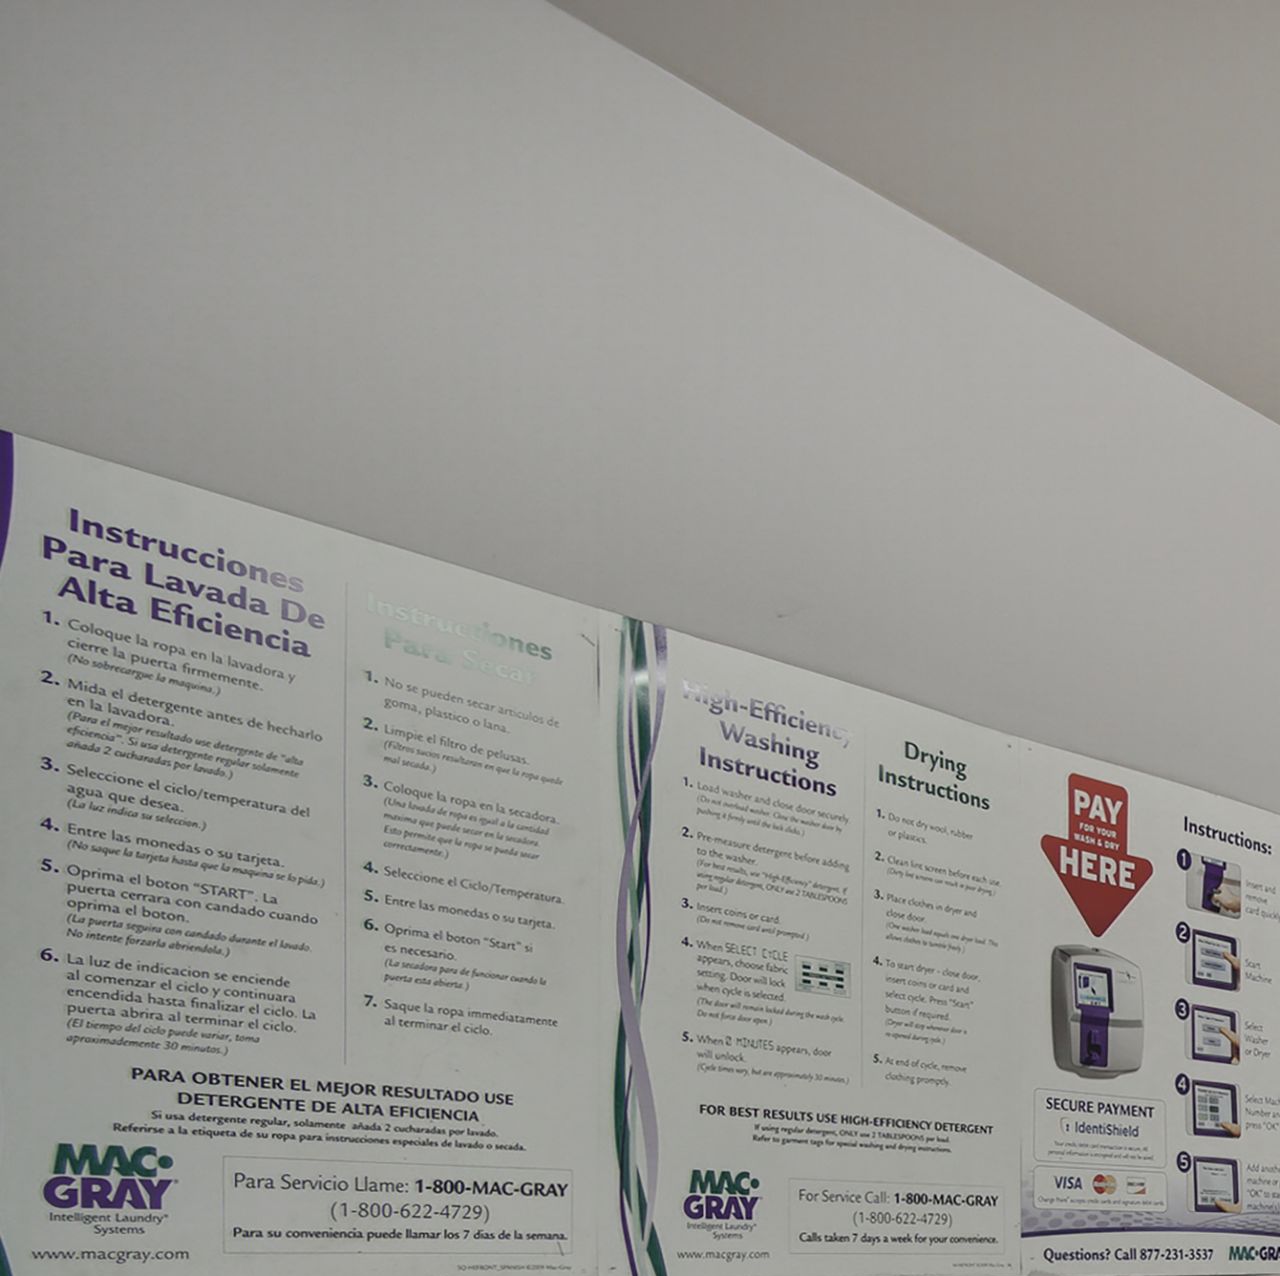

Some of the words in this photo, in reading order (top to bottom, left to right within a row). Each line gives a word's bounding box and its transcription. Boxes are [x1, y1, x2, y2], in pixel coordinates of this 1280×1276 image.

[69, 507, 305, 593] Instrucciones
[41, 533, 132, 580] Para
[144, 561, 269, 616] Lavada
[280, 597, 324, 629] De
[56, 575, 138, 615] Alta
[150, 595, 311, 658] Eficiencia
[41, 609, 61, 627] 1.
[66, 617, 132, 644] Coloque
[135, 632, 149, 648] la
[151, 640, 186, 657] ropa
[189, 649, 207, 661] en
[210, 650, 223, 665] la
[226, 654, 285, 679] lavadora
[287, 672, 296, 684] y
[65, 636, 109, 656] cierre
[111, 645, 126, 660] la
[129, 652, 177, 672] puerta
[181, 661, 263, 691] firmemente.
[719, 720, 820, 770] Washing
[699, 745, 837, 797] Instructions
[903, 739, 967, 782] Drying
[877, 763, 990, 811] Instructions
[1073, 787, 1124, 825] PAY
[1072, 831, 1096, 845] WASH
[1095, 837, 1103, 847] &
[1103, 839, 1120, 851] DRY
[1078, 821, 1095, 833] FOR
[1095, 825, 1117, 839] YOUR
[1182, 814, 1272, 855] Instructions:
[1055, 844, 1136, 890] HERE
[1181, 852, 1187, 866] 1
[1178, 925, 1187, 940] 2
[1178, 1002, 1187, 1017] 3
[130, 1066, 186, 1084] PARA
[190, 1070, 285, 1091] OBTENER
[289, 1077, 311, 1092] EL
[315, 1079, 377, 1098] MEJOR
[381, 1083, 480, 1103] RESULTADO
[483, 1091, 514, 1106] USE
[1178, 1078, 1187, 1093] 4
[176, 1090, 306, 1112] DETERGENTE
[310, 1099, 337, 1114] DE
[340, 1101, 384, 1117] ALTA
[388, 1104, 479, 1122] EFICIENCIA
[1045, 1095, 1094, 1114] SECURE
[1096, 1100, 1155, 1119] PAYMENT
[698, 1102, 726, 1116] FOR
[728, 1105, 760, 1118] BEST
[762, 1107, 814, 1123] RESULTS
[815, 1111, 837, 1124] USE
[839, 1113, 932, 1131] HIGH-EFFICIENCY
[933, 1120, 994, 1135] DETERGENT
[1073, 1120, 1140, 1138] IdentiShield
[1179, 1155, 1187, 1170] 5
[41, 1174, 173, 1210] GRAY
[233, 1171, 275, 1190] Para
[279, 1172, 349, 1192] Servicio
[354, 1175, 409, 1193] Llame:
[414, 1178, 569, 1197] 1-800-MAC-GRAY
[1053, 1175, 1083, 1190] VISA
[682, 1193, 759, 1221] GRAY
[798, 1187, 819, 1202] For
[821, 1188, 862, 1204] Service
[863, 1190, 890, 1204] Call:
[893, 1191, 999, 1207] 1-800-MAC-GRAY
[48, 1211, 112, 1225] Intelligent
[329, 1200, 490, 1224] (1-800-622-4729)
[851, 1210, 953, 1228] (1-800-622-4729)
[93, 1224, 146, 1237] Systems
[232, 1225, 264, 1238] Para
[266, 1229, 282, 1238] su
[284, 1226, 364, 1239] conveniencia
[365, 1227, 403, 1242] puede
[404, 1227, 442, 1240] llamar
[442, 1227, 460, 1240] los
[462, 1228, 471, 1240] 7
[496, 1228, 512, 1240] de
[512, 1229, 524, 1240] la
[524, 1232, 568, 1241] semana.
[797, 1231, 823, 1243] Calls
[822, 1230, 851, 1243] taken
[851, 1231, 859, 1243] 7
[859, 1231, 881, 1246] days
[882, 1234, 889, 1243] a
[889, 1232, 913, 1244] week
[913, 1232, 928, 1244] for
[927, 1235, 949, 1247] your
[948, 1235, 998, 1244] convenience.
[30, 1249, 190, 1265] www.macgray.com
[675, 1250, 770, 1263] www.macgray.com
[1042, 1246, 1112, 1264] Questions?
[1112, 1246, 1137, 1261] Call
[1138, 1247, 1214, 1261] 877-231-3537
